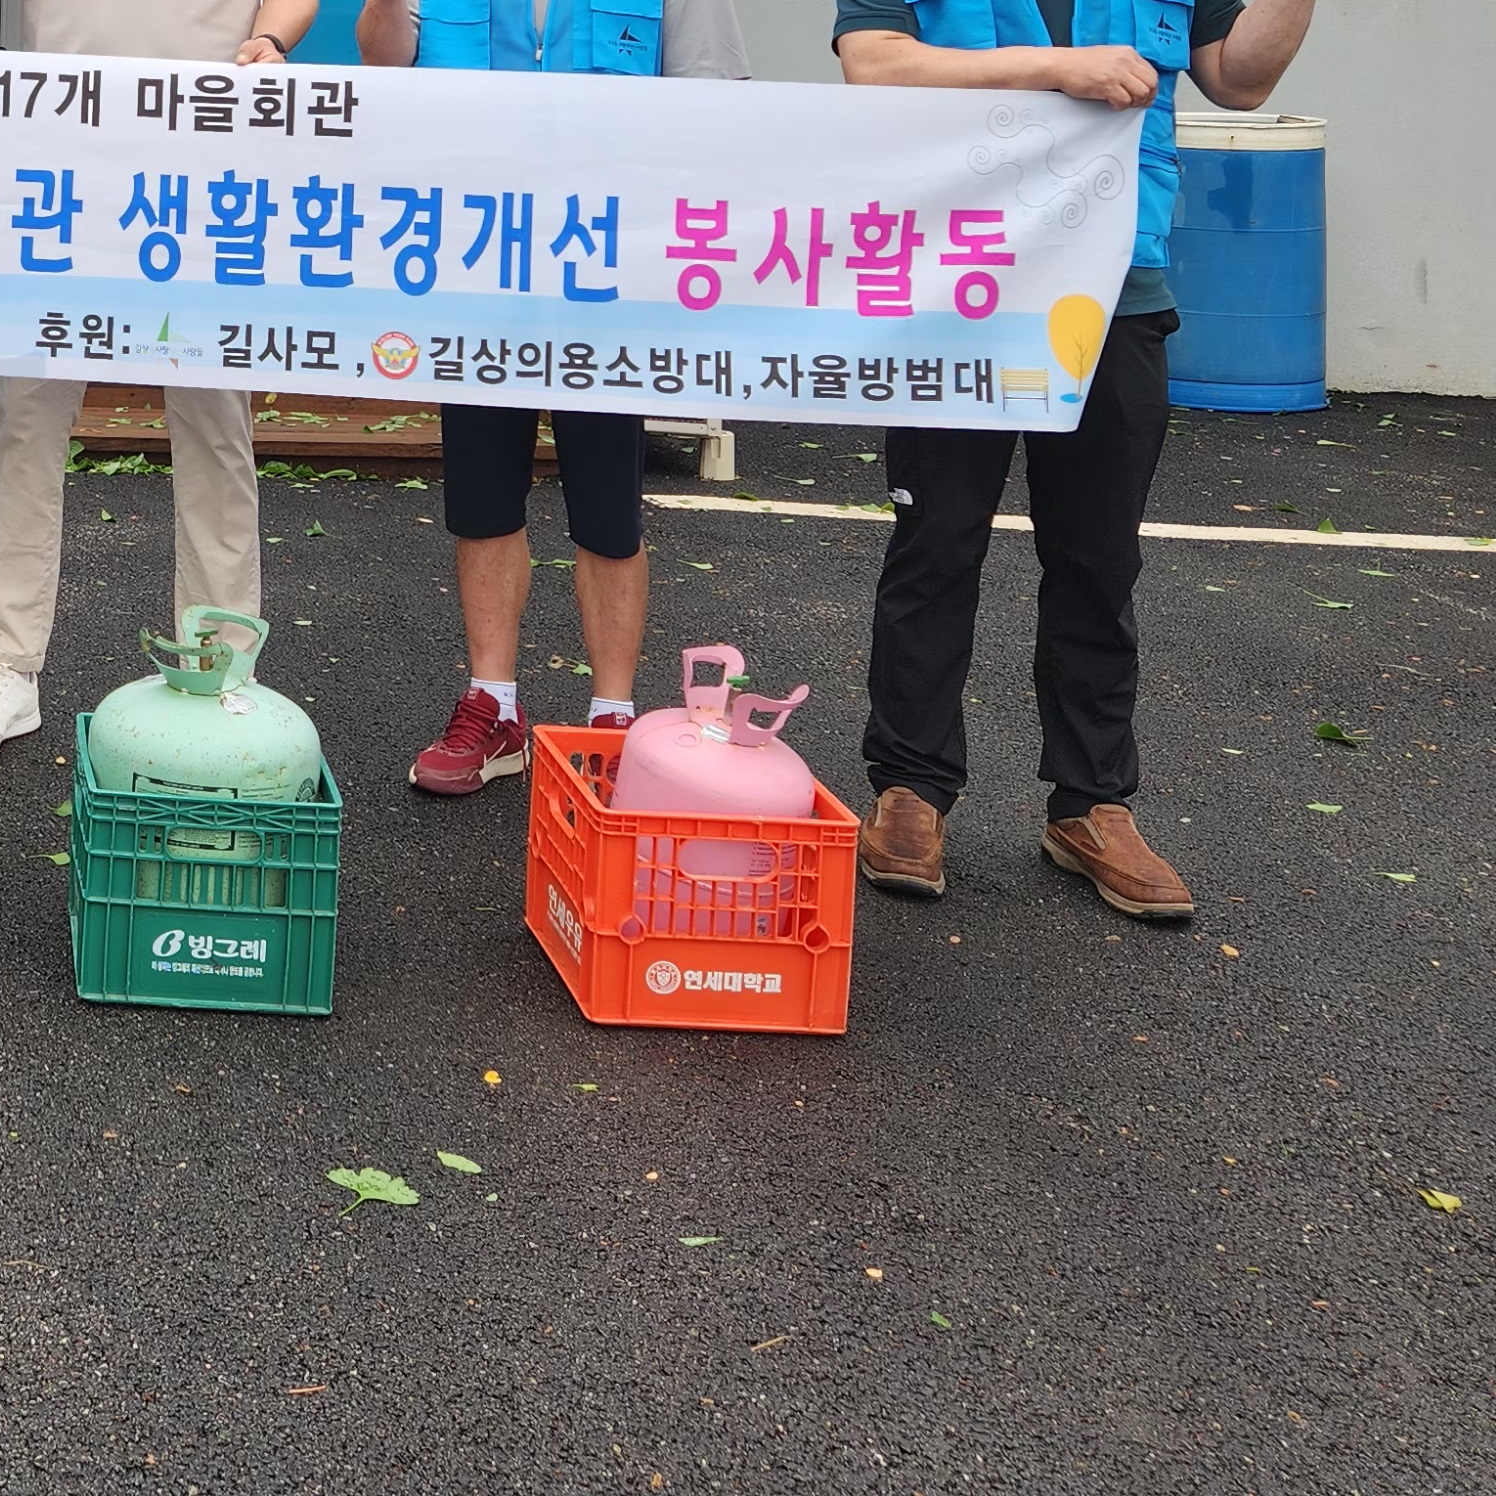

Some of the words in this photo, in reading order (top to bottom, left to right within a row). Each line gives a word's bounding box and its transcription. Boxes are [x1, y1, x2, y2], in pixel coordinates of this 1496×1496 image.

[137, 75, 359, 138] 마을회관
[119, 170, 619, 303] 생활환경개선
[666, 198, 1015, 320] 봉사활동
[35, 312, 132, 361] 후원:
[188, 935, 267, 963] 빙그레
[683, 970, 782, 994] 연세대학교
